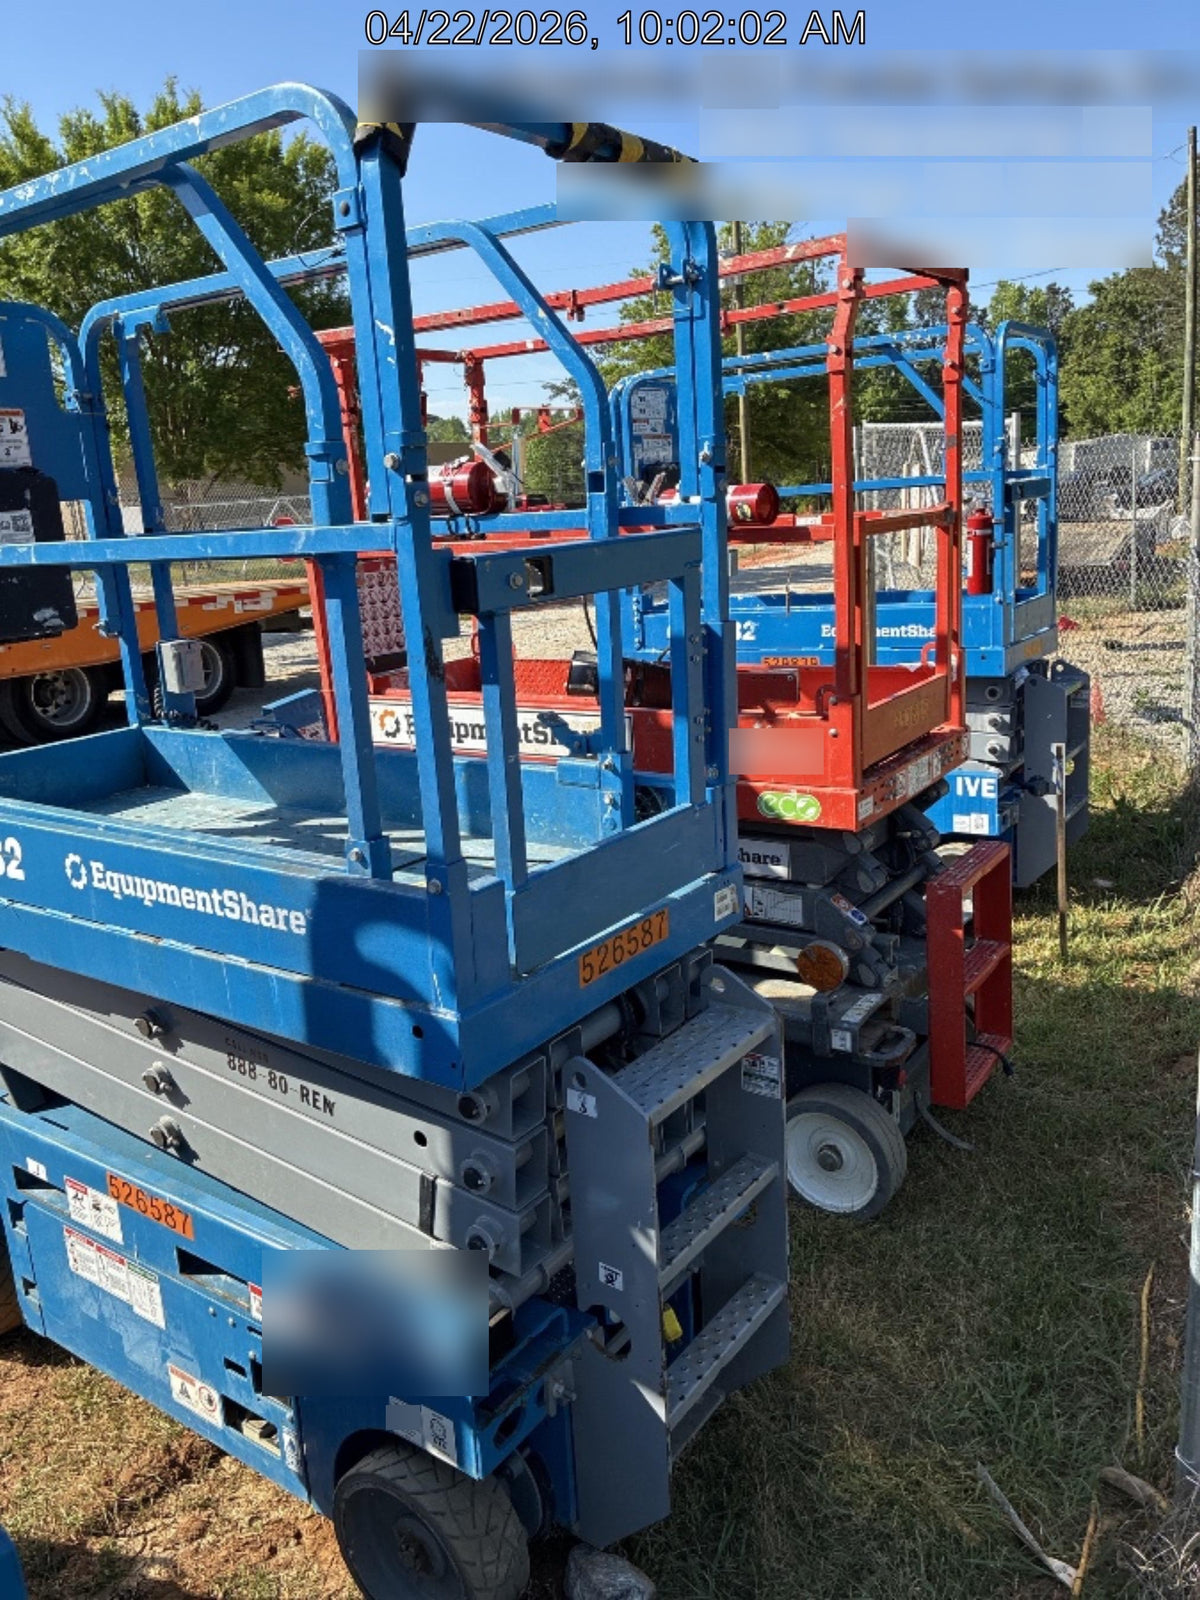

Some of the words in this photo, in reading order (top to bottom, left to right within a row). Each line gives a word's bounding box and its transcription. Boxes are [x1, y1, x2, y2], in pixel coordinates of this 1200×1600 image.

[0, 837, 25, 880] 2
[90, 860, 308, 935] EquipmentShare
[582, 911, 667, 984] 526587
[109, 1174, 189, 1235] 526587
